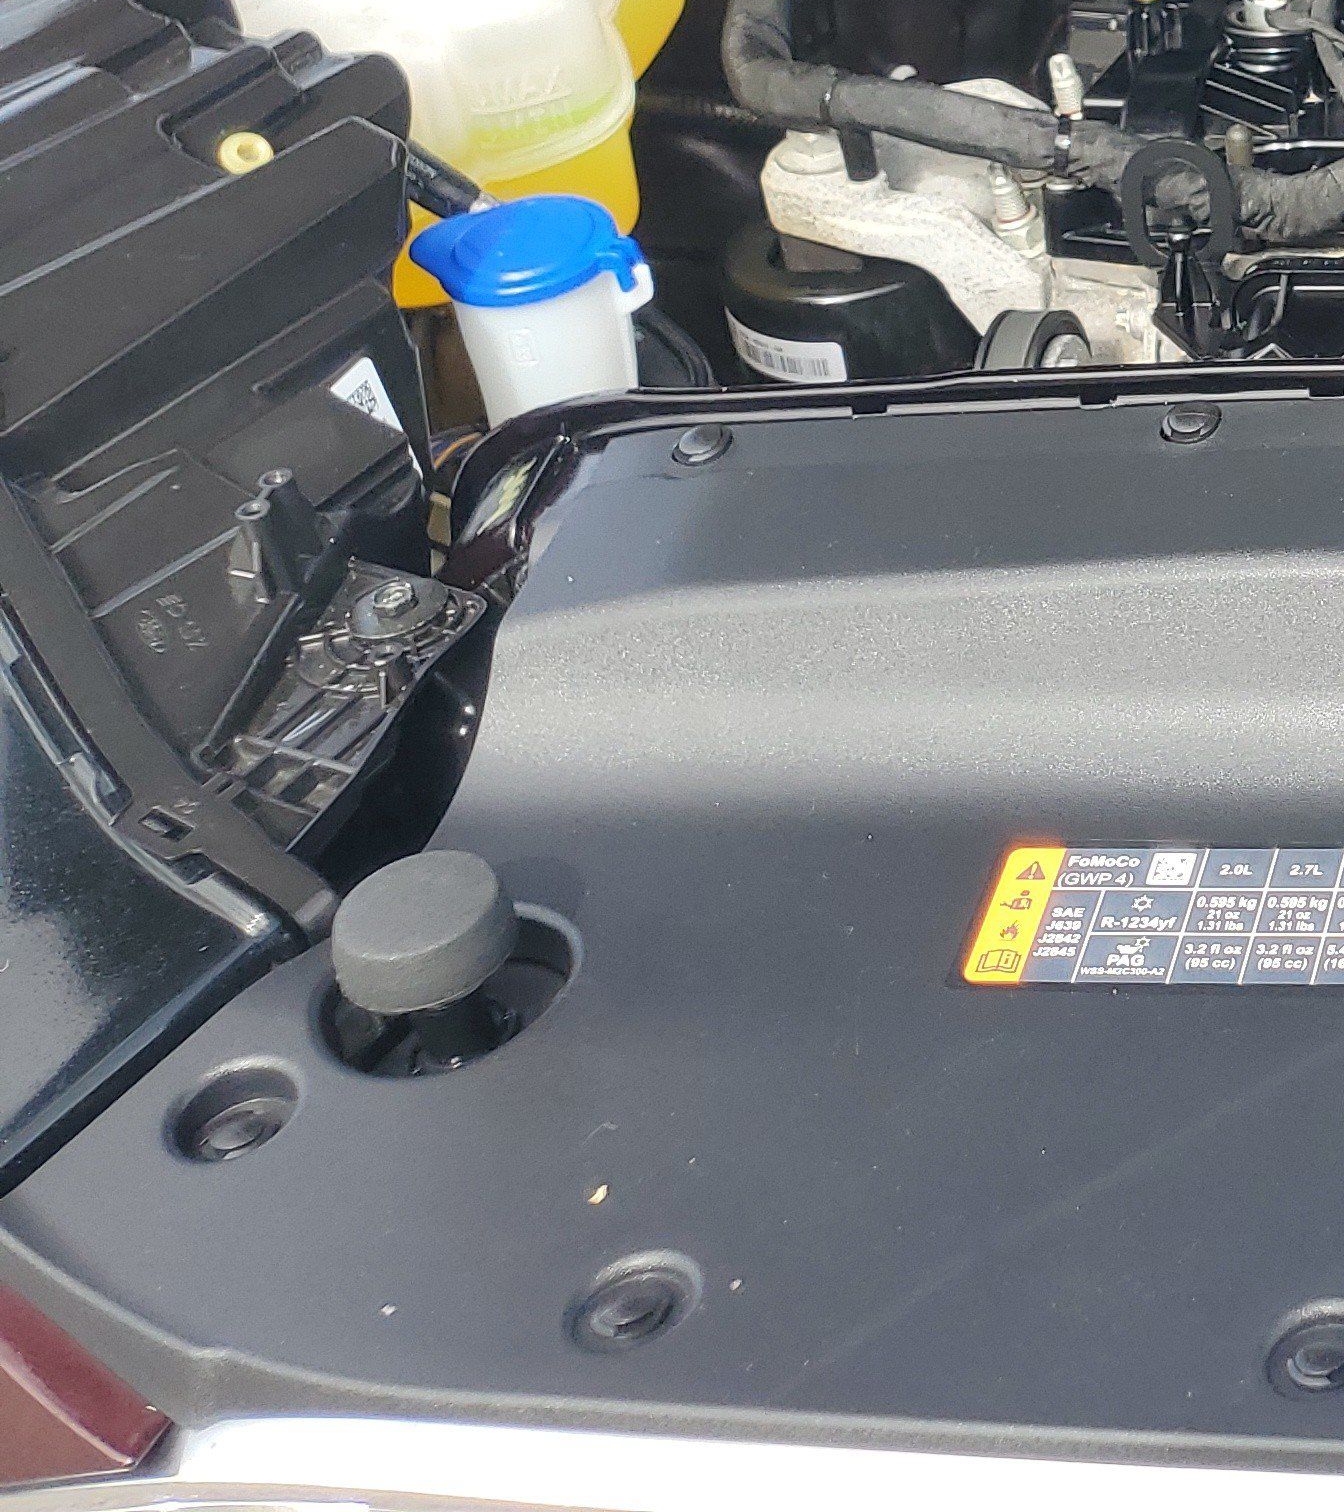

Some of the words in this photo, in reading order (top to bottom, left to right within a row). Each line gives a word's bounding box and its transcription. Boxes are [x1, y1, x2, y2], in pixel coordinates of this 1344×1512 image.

[1068, 856, 1141, 867] FoMoCo
[1220, 864, 1252, 875] 2.0L
[1289, 864, 1323, 876] 2.7L
[1058, 873, 1112, 887] (GWP
[1115, 872, 1133, 887] 4)
[1197, 896, 1236, 908] 0.595
[1239, 896, 1257, 911] kg
[1267, 896, 1306, 908] 0.595
[1309, 897, 1328, 911] kg
[1052, 907, 1085, 917] SAE
[1206, 910, 1221, 920] 21
[1225, 912, 1240, 920] oz
[1278, 910, 1292, 920] 21
[1296, 912, 1311, 920] oz
[1101, 916, 1177, 931] R-1234yf
[1198, 921, 1220, 930] 1.31
[1225, 921, 1244, 931] lbs
[1269, 921, 1291, 931] 1.31
[1296, 921, 1314, 931] lbs
[1185, 943, 1207, 954] 3.2
[1210, 944, 1221, 954] fl
[1224, 946, 1242, 954] oz
[1256, 944, 1279, 954] 3.2
[1282, 944, 1292, 955] fl
[1296, 946, 1314, 955] oz
[1106, 954, 1145, 966] PAG
[1185, 958, 1209, 970] (95
[1212, 958, 1236, 969] cc)
[1258, 958, 1281, 971] (95
[1284, 958, 1308, 971] cc)
